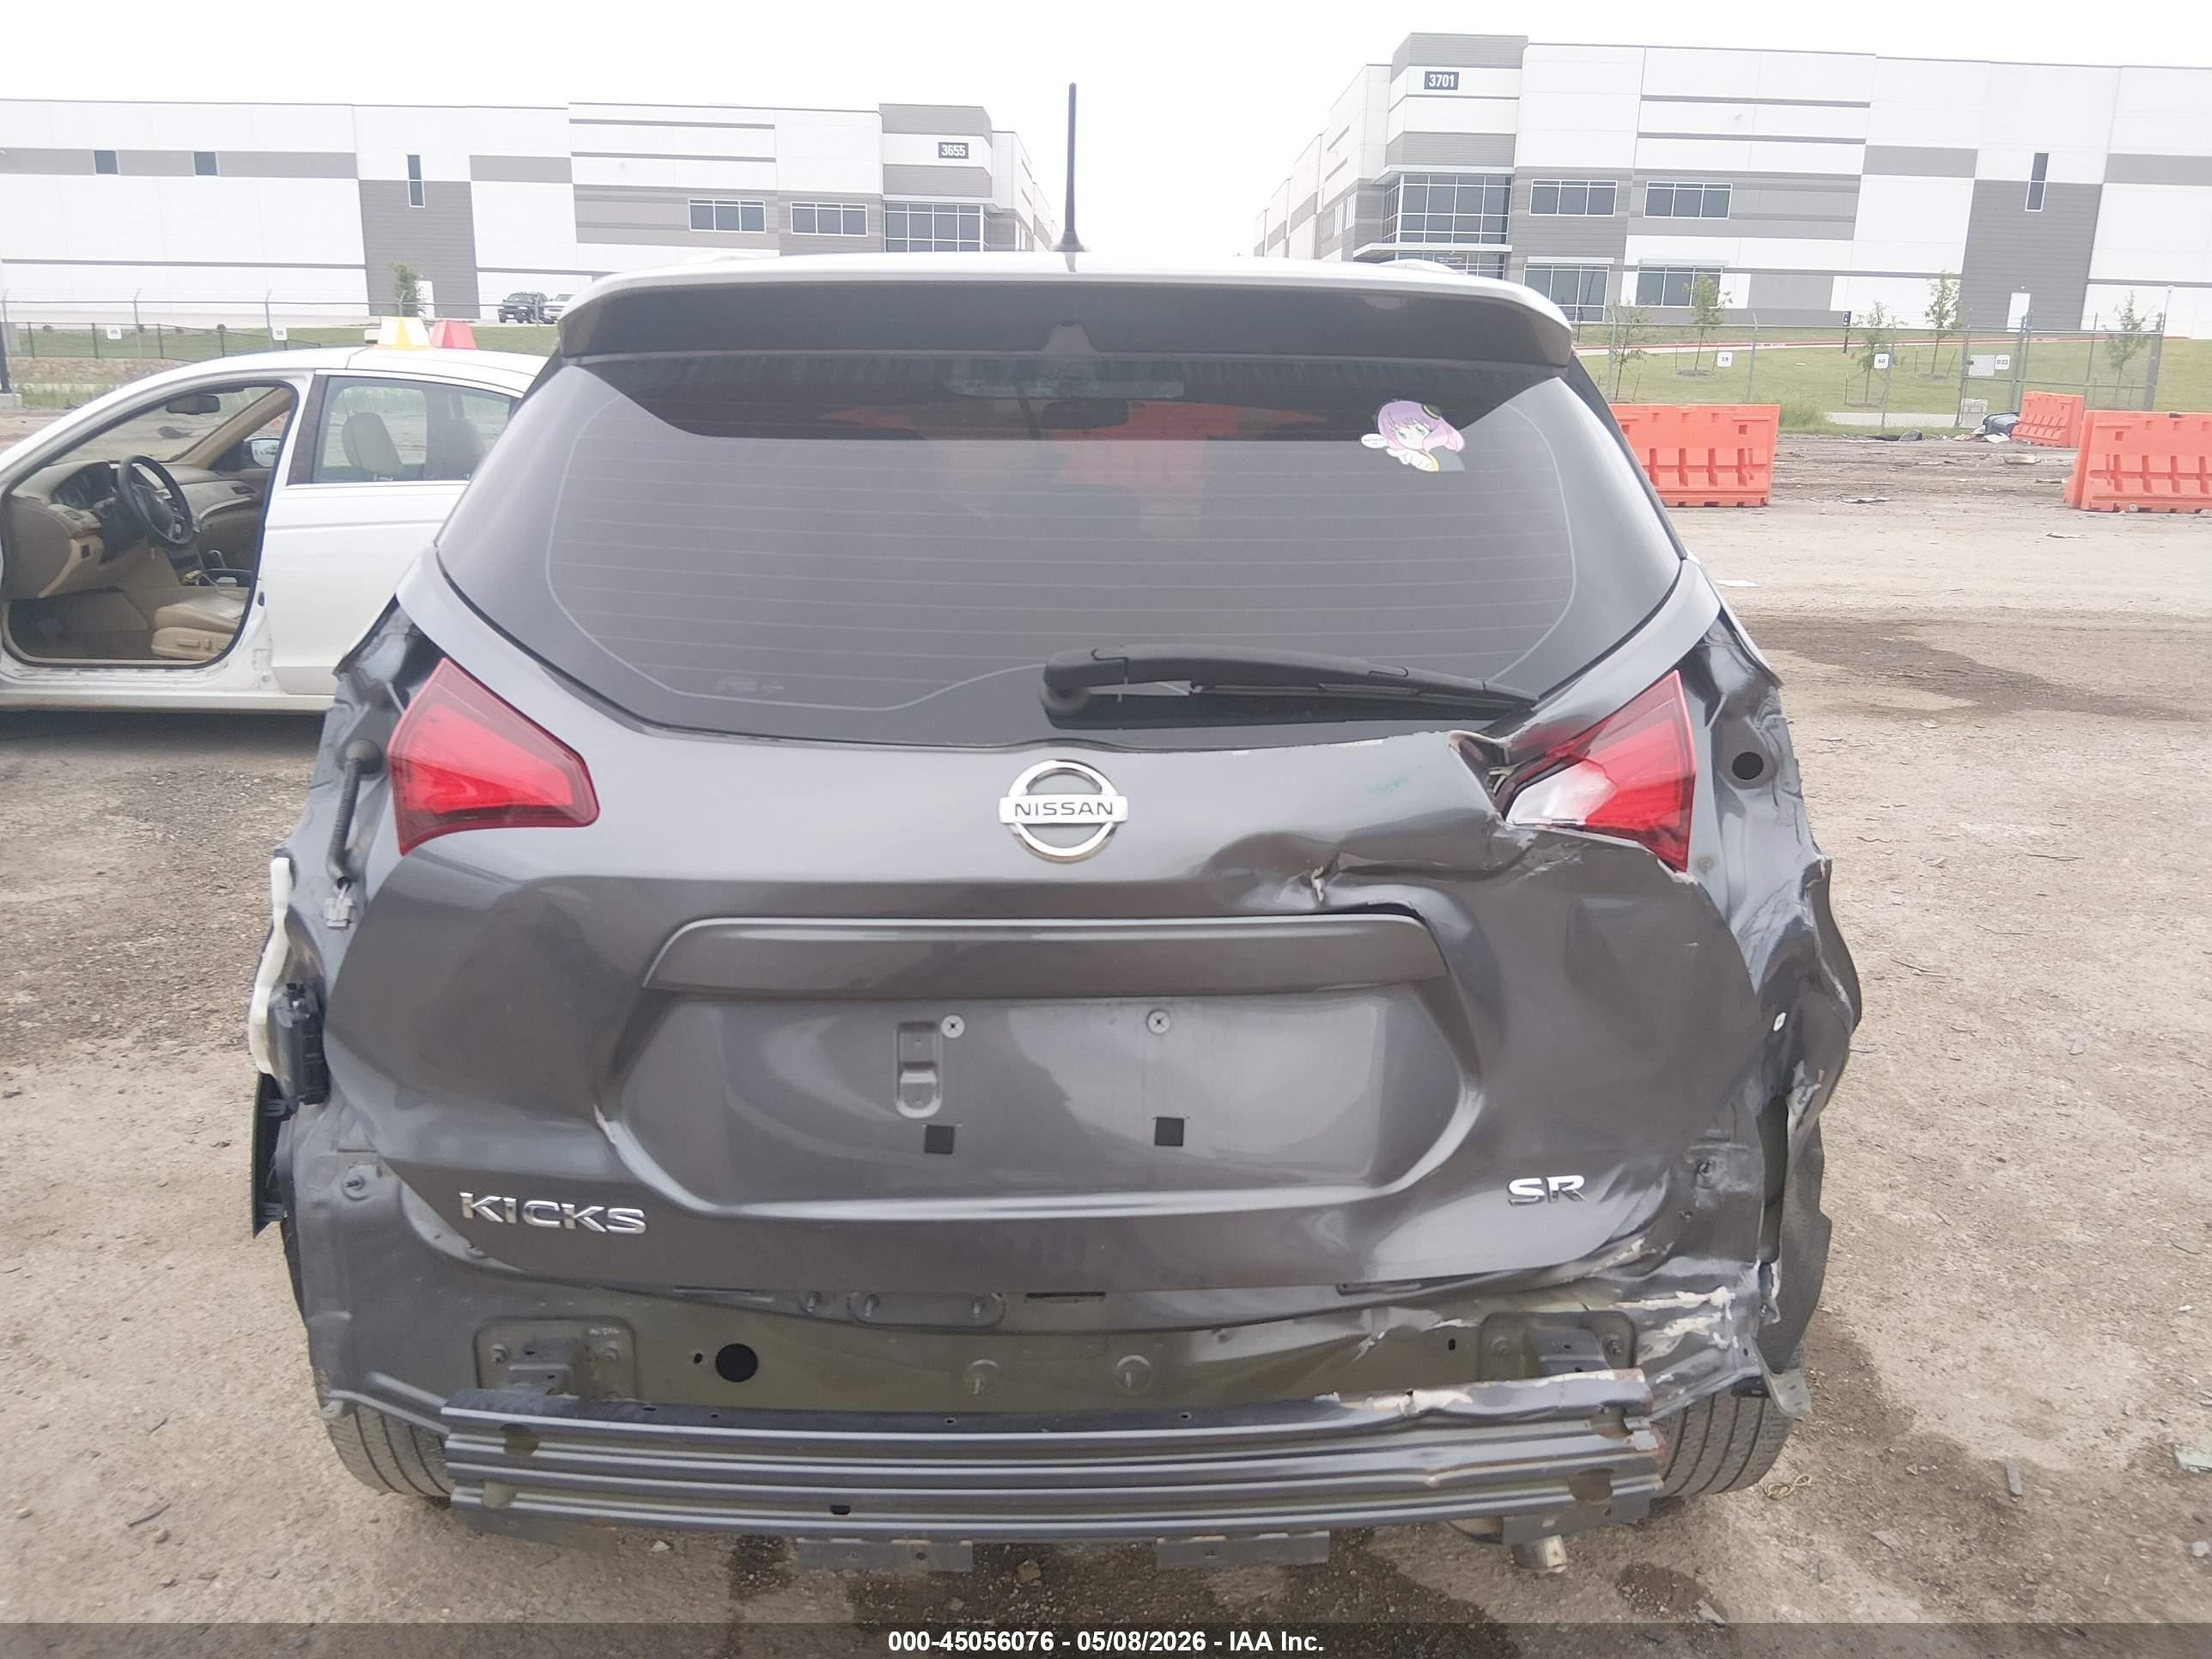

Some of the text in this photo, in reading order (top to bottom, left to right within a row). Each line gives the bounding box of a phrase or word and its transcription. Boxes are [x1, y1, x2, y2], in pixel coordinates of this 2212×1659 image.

[1428, 74, 1455, 88] 3701
[941, 144, 966, 156] 3655
[1014, 802, 1114, 817] NISSAN
[1508, 1175, 1588, 1204] SR
[459, 1192, 647, 1234] KICKS
